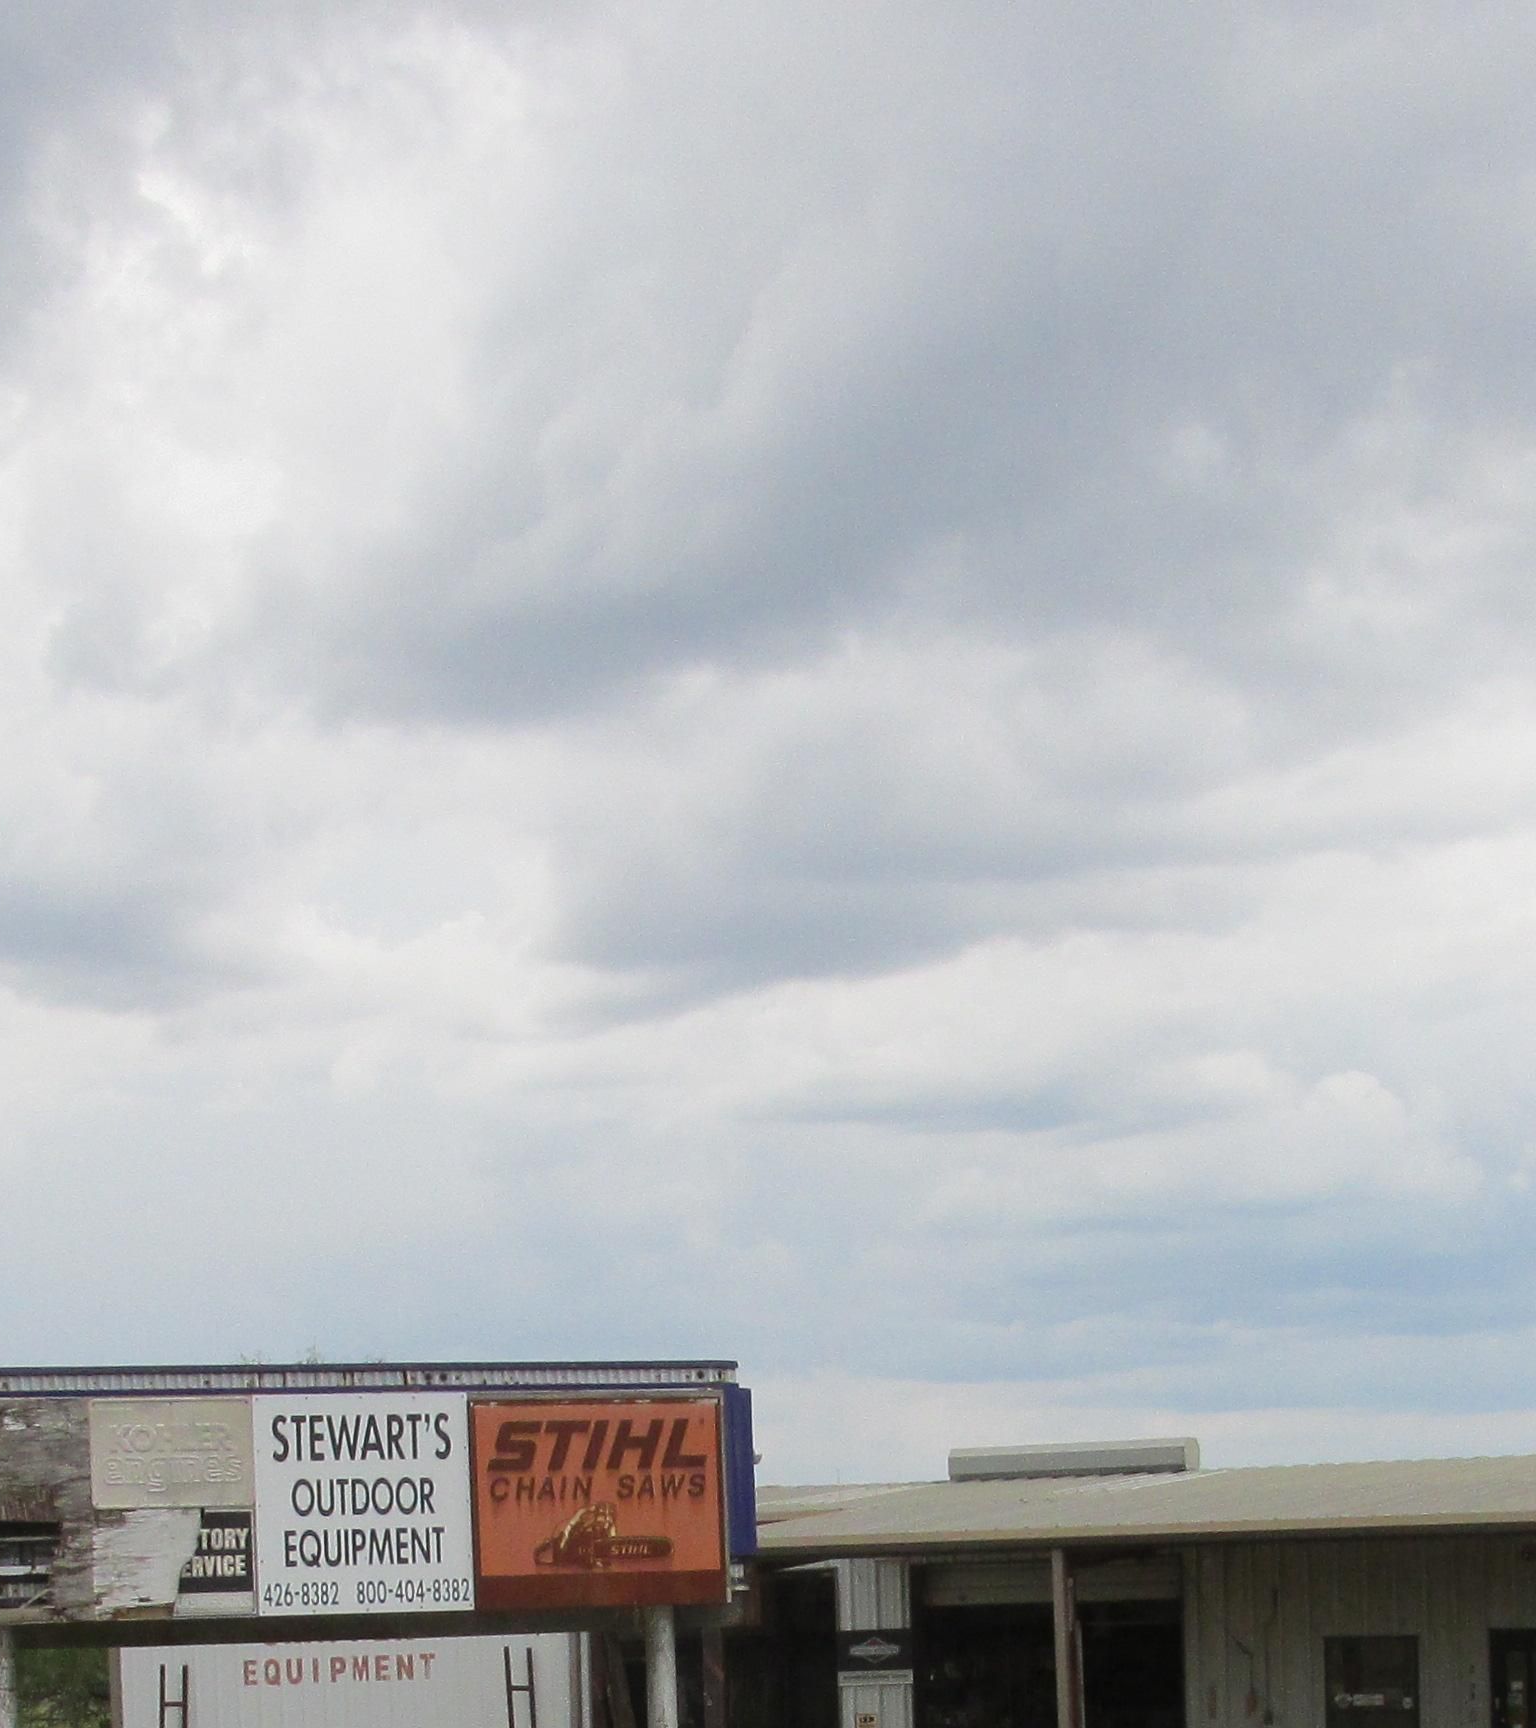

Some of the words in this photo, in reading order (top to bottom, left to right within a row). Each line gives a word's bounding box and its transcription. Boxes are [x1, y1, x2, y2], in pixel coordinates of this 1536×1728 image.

[272, 1412, 451, 1462] STEWART'S
[487, 1418, 708, 1473] STIHL
[291, 1477, 436, 1516] OUTDOOR
[490, 1477, 592, 1503] CHAIN
[617, 1474, 706, 1499] SAWS
[284, 1527, 445, 1568] EQUIPMENT
[611, 1544, 651, 1556] STIHL
[264, 1582, 339, 1606] 426-8382
[357, 1578, 470, 1604] 800-404-8382
[243, 1653, 435, 1687] EQUIPMENT
